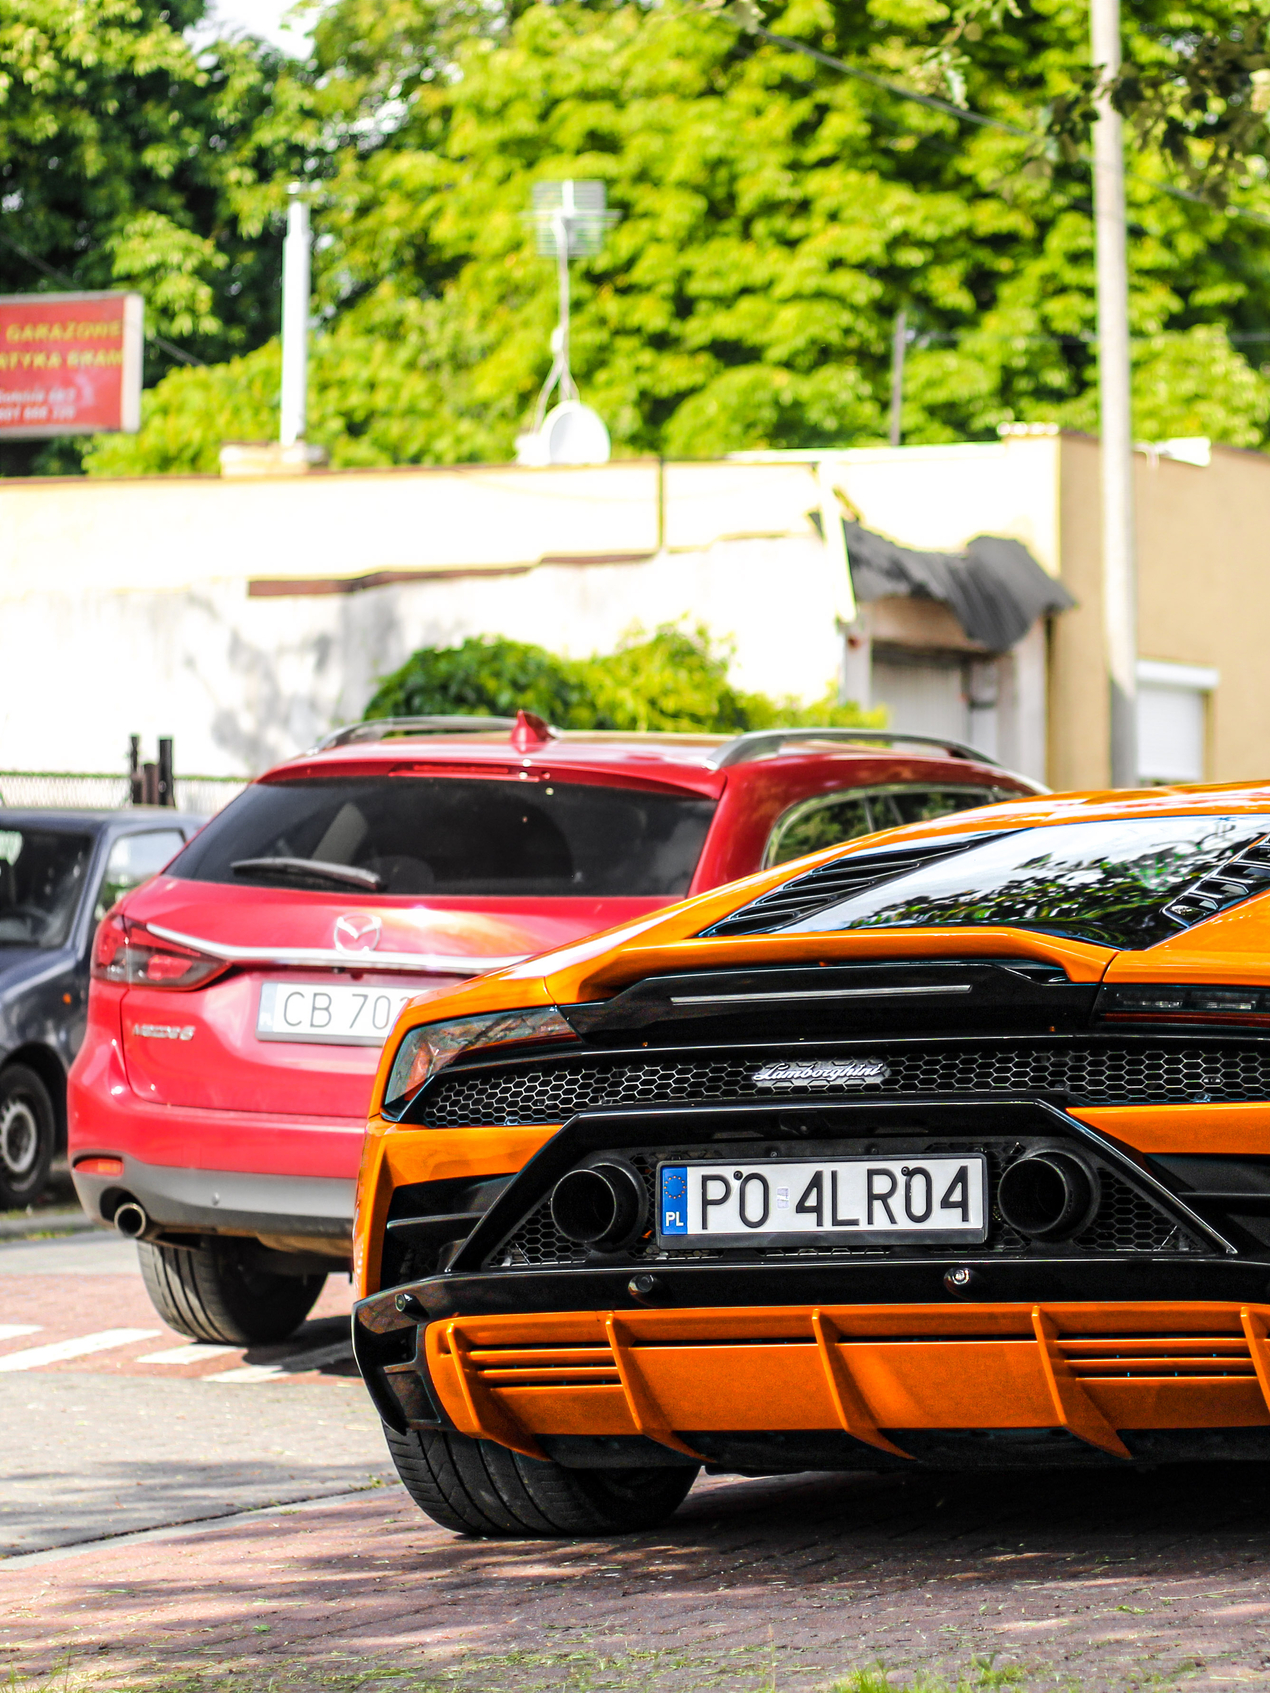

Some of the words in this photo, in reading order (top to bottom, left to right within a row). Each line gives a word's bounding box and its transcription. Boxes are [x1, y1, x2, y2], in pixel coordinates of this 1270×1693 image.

[283, 991, 332, 1028] CB
[753, 1062, 884, 1081] Lamborghini
[701, 1173, 770, 1229] PO
[796, 1165, 969, 1227] 4LR04
[666, 1212, 684, 1227] PL
